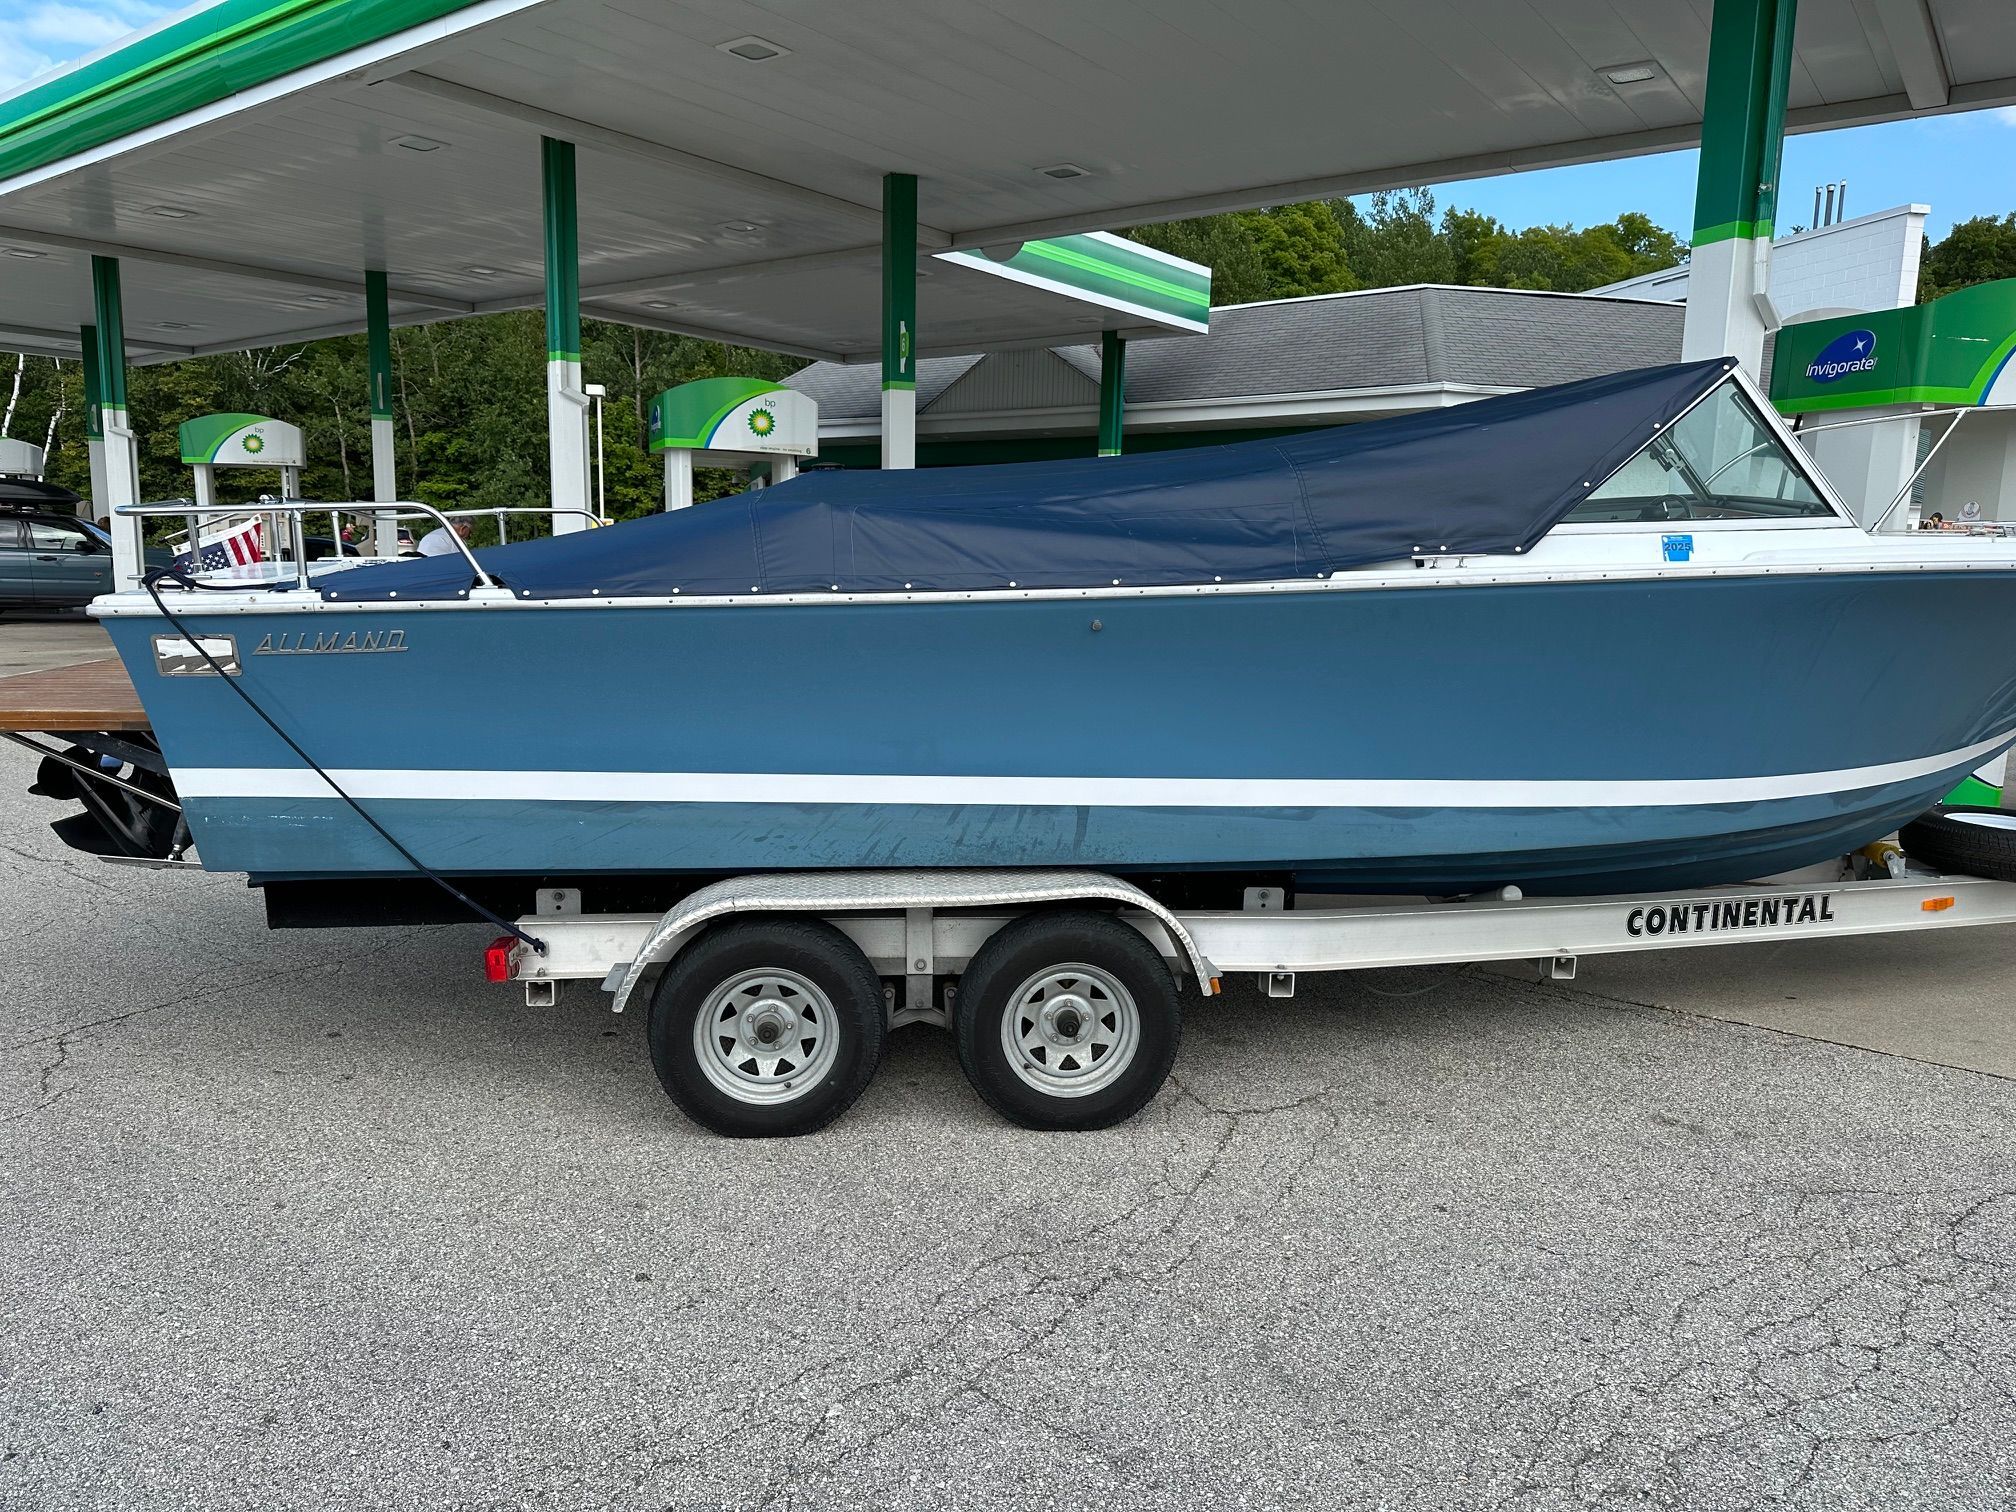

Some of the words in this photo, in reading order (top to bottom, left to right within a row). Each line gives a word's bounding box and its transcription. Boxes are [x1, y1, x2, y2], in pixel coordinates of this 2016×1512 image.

[1805, 357, 1875, 378] Invigorate
[764, 398, 776, 408] bp
[254, 426, 265, 434] bp
[1664, 542, 1691, 552] 2025
[253, 629, 408, 655] ALLMAND
[1626, 893, 1835, 938] CONTINENTAL
